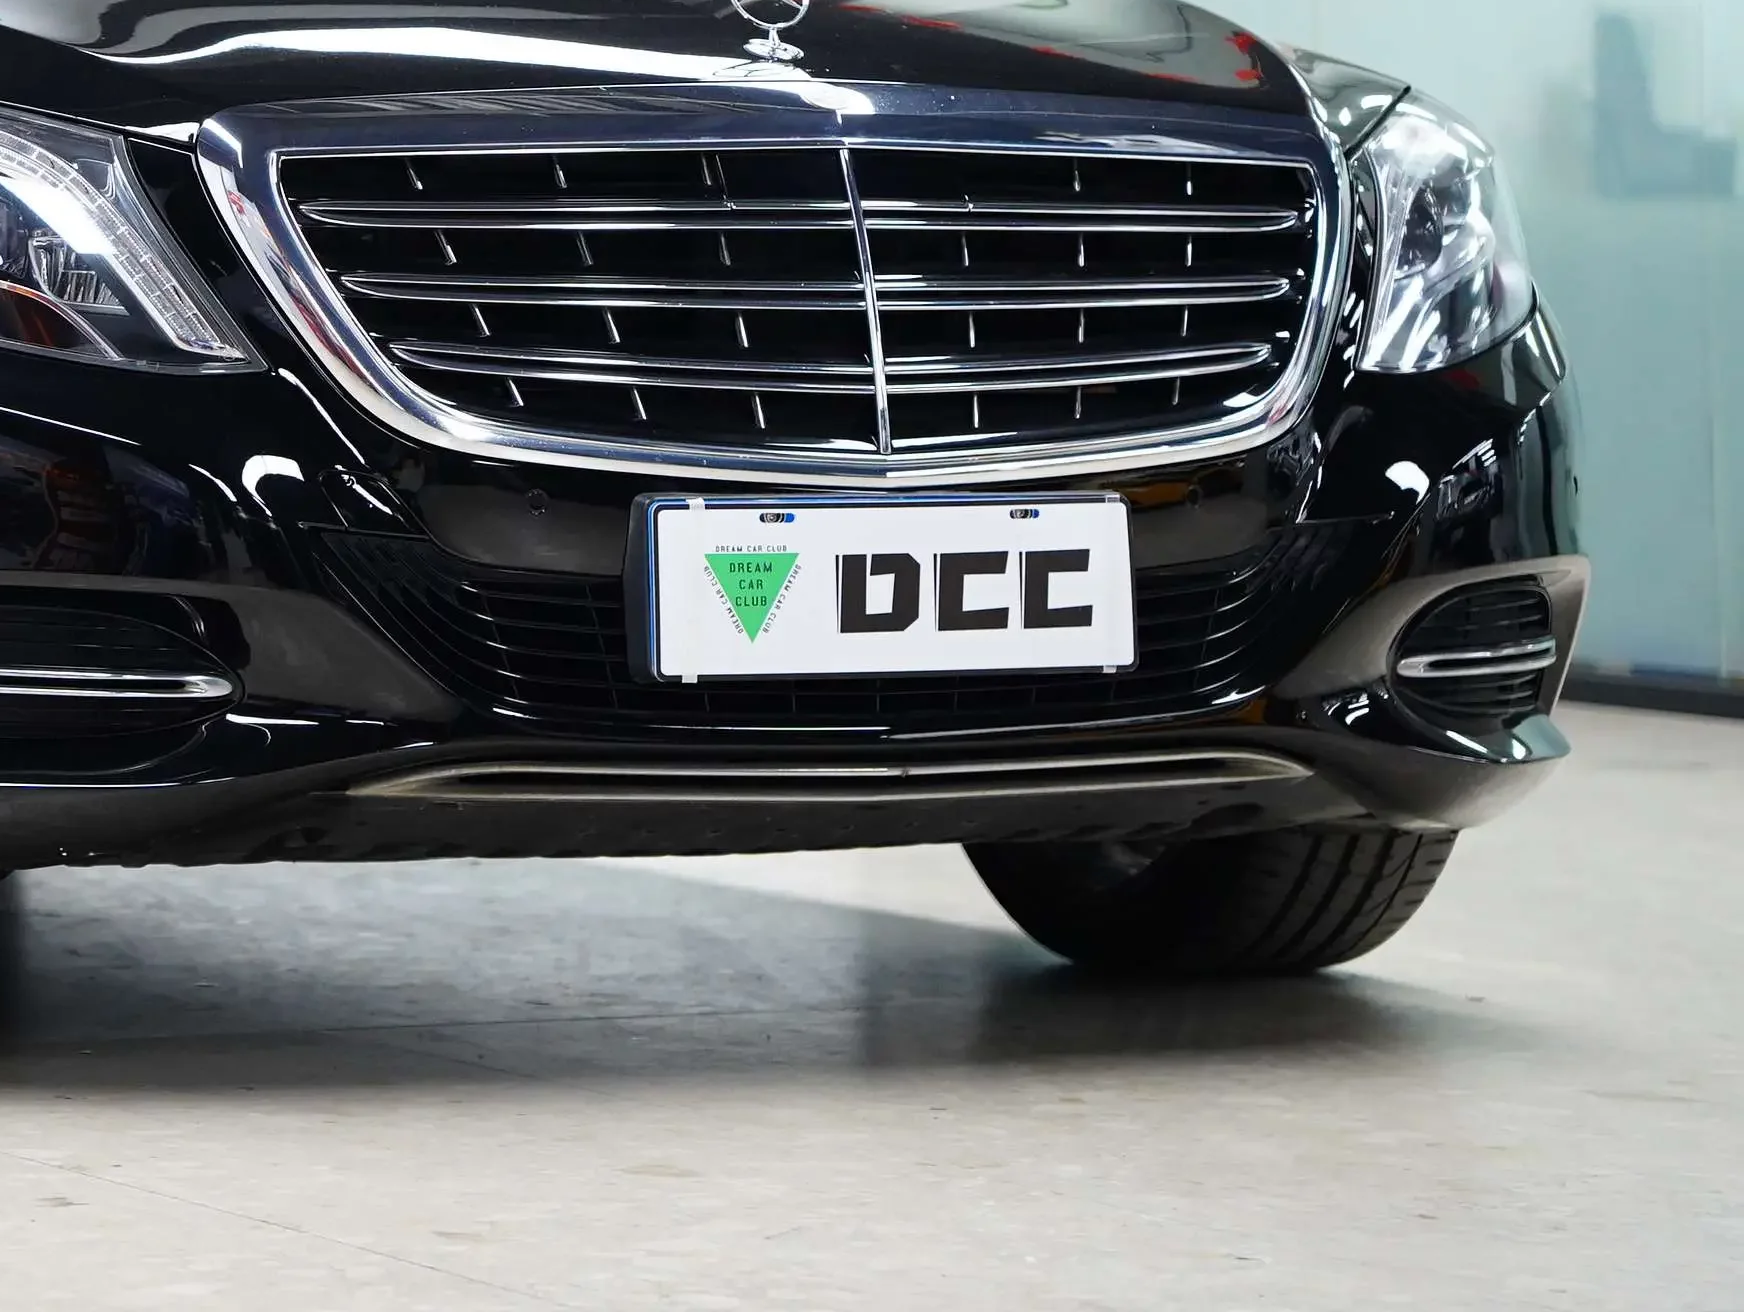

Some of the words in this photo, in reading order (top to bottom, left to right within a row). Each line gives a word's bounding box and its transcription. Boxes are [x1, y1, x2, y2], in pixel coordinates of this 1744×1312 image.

[715, 545, 743, 553] DREAM
[746, 545, 763, 553] CAR
[766, 545, 787, 553] CLUB
[729, 561, 773, 573] DREAM
[738, 578, 764, 590] CAR
[835, 549, 1094, 634] DCC
[735, 595, 768, 607] CLUB
